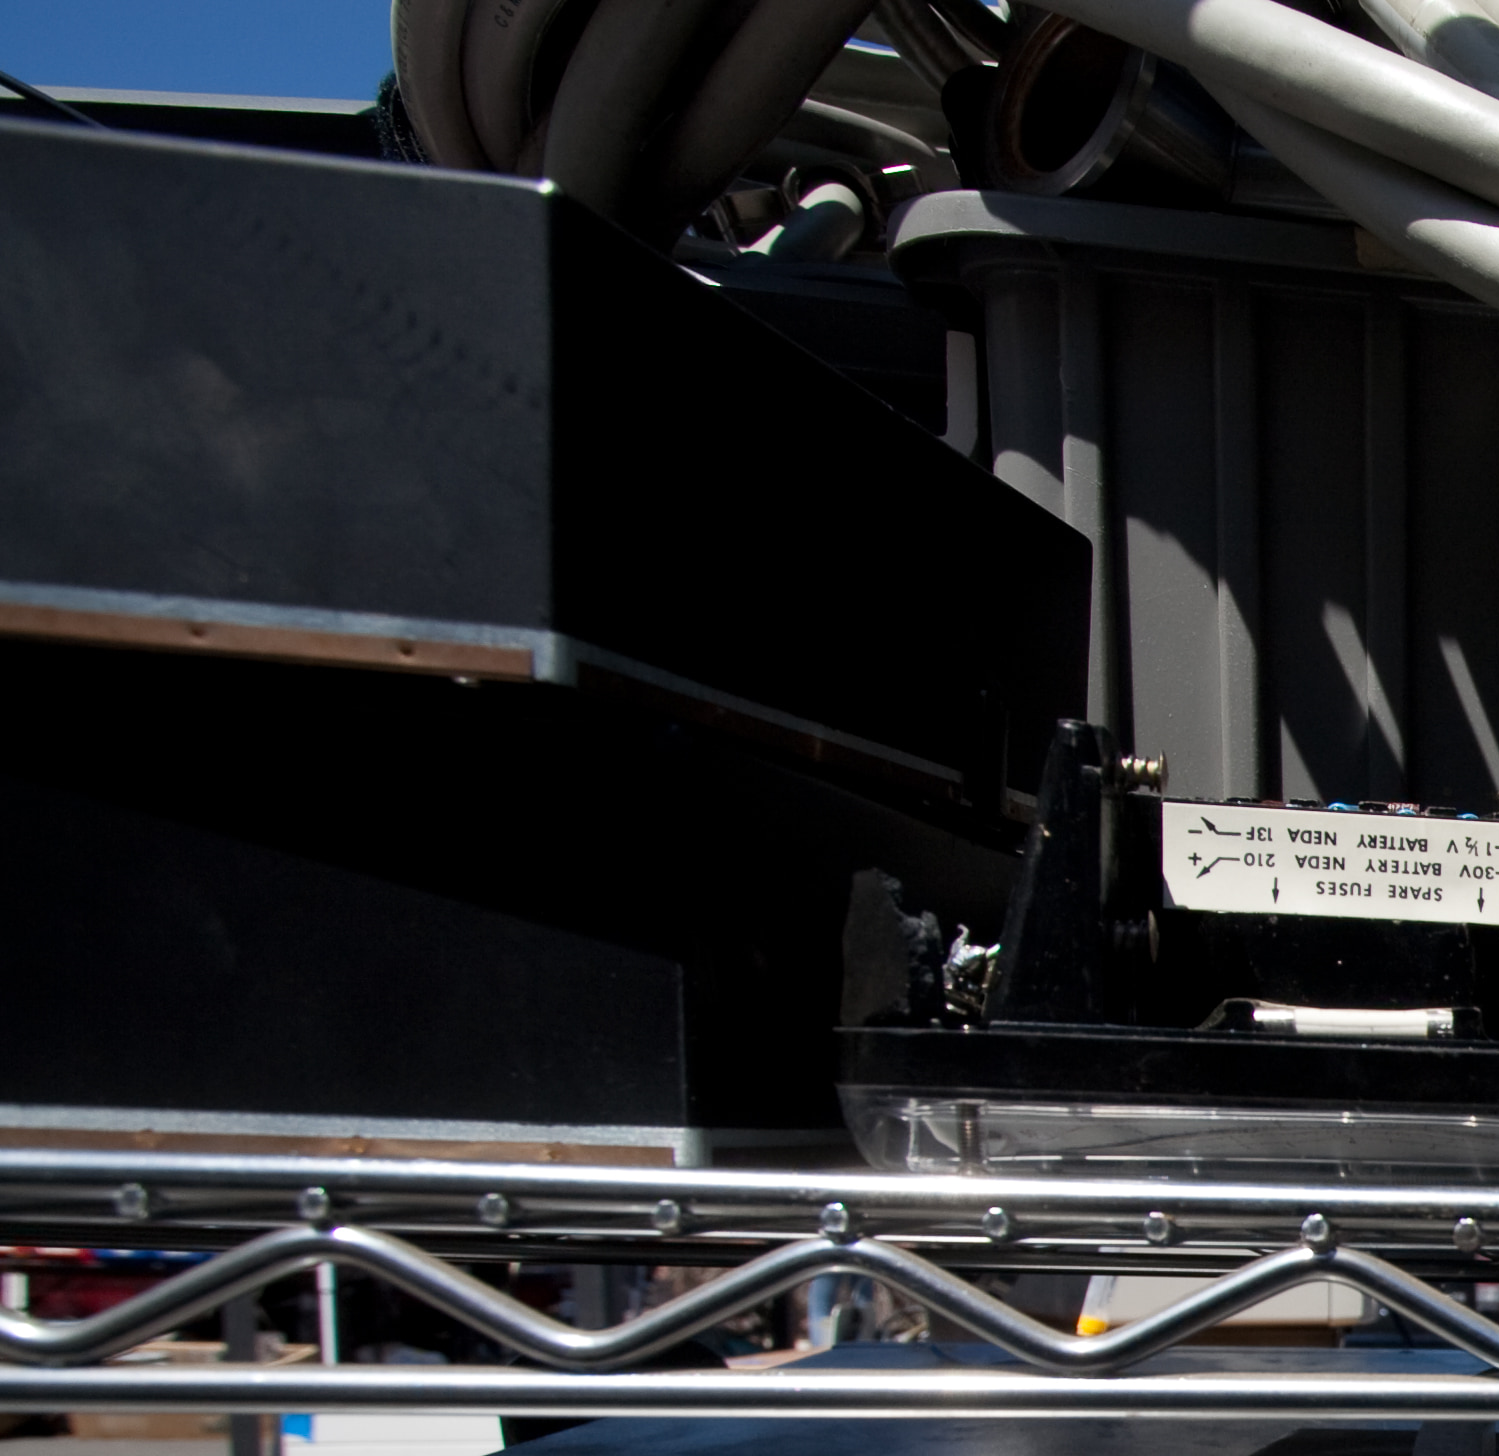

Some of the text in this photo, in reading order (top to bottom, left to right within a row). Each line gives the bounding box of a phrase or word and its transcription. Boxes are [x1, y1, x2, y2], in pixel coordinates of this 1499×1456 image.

[1245, 826, 1274, 842] 13F
[1287, 827, 1338, 847] NEDA
[1356, 833, 1429, 852] BATTERY
[1446, 838, 1459, 854] V
[1243, 852, 1496, 880] 30V BATTERY NEDA 210
[1315, 880, 1443, 903] SPARE FUSES
